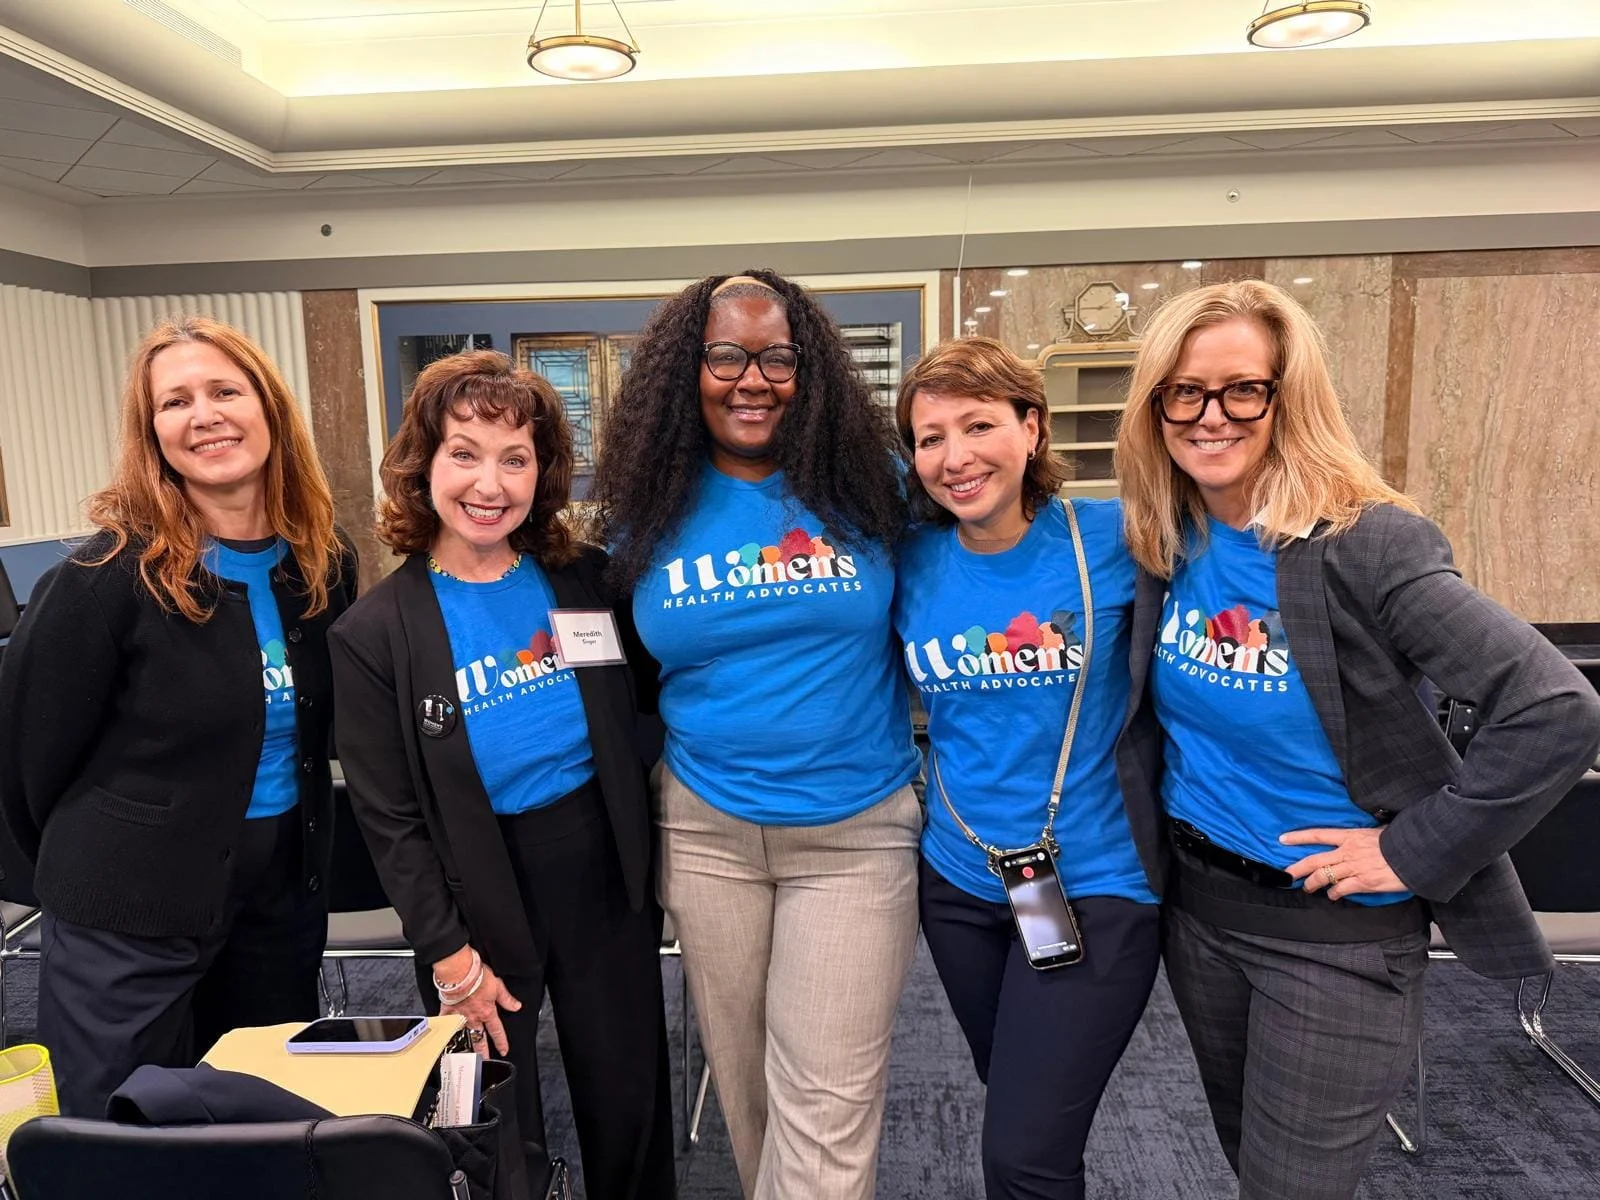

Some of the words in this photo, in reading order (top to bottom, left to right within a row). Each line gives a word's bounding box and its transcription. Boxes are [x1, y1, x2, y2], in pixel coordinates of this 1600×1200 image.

[662, 550, 857, 595] Women's
[663, 591, 735, 609] HEALTH
[746, 580, 863, 599] ADVOCATES
[573, 630, 603, 638] Meredith
[980, 672, 1076, 690] ADVOCATE
[1153, 643, 1176, 665] ALTH
[1178, 661, 1288, 693] ADVOCATES
[464, 691, 514, 716] HEALTH
[520, 670, 576, 696] ADVOCAT
